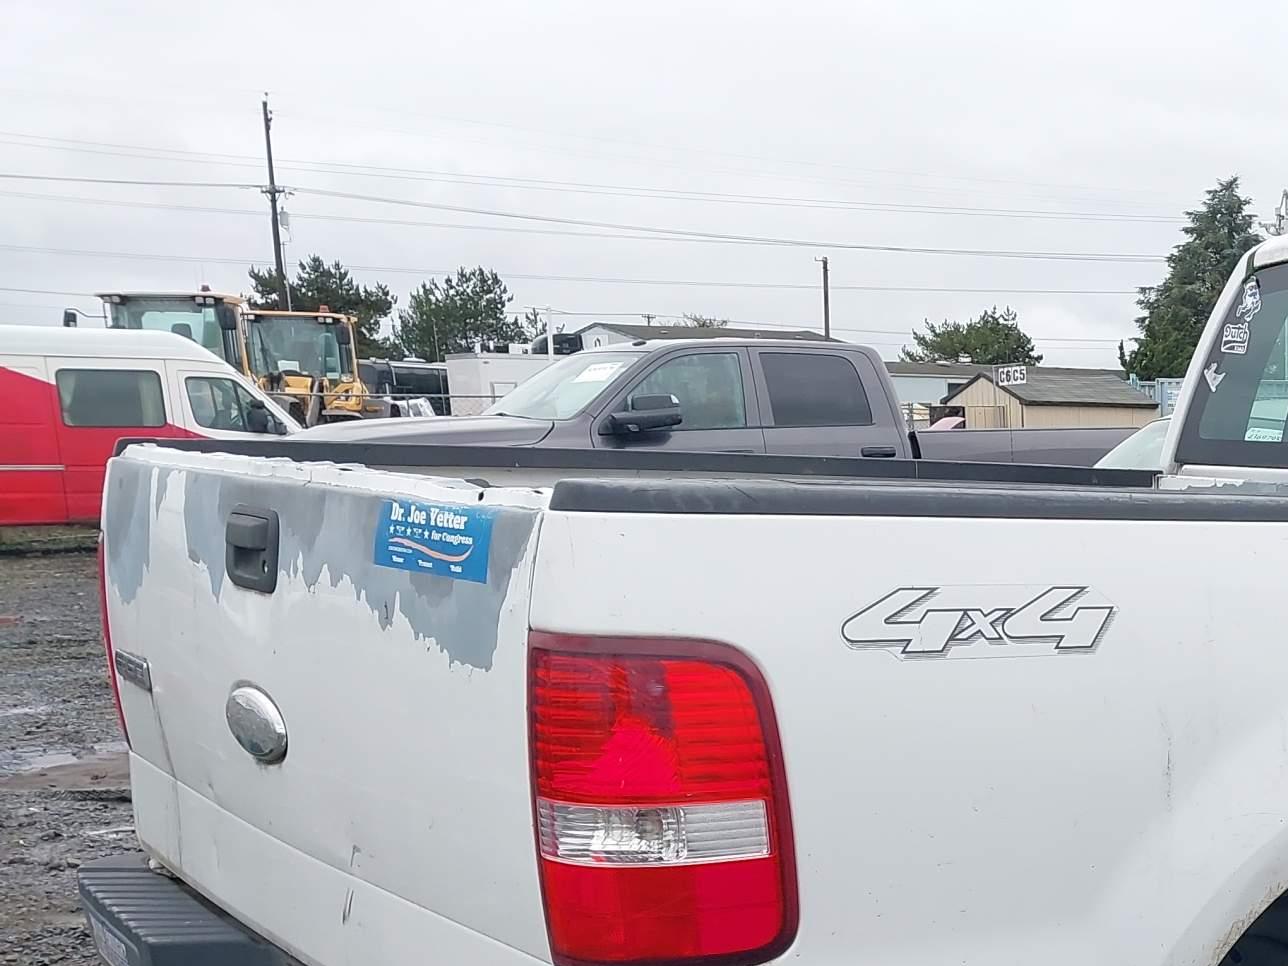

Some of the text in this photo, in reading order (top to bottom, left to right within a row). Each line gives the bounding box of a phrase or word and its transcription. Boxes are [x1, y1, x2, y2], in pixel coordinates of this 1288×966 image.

[390, 502, 468, 529] Dr. Joe Yetter
[431, 530, 473, 546] for Congress
[841, 585, 1117, 658] 4x4
